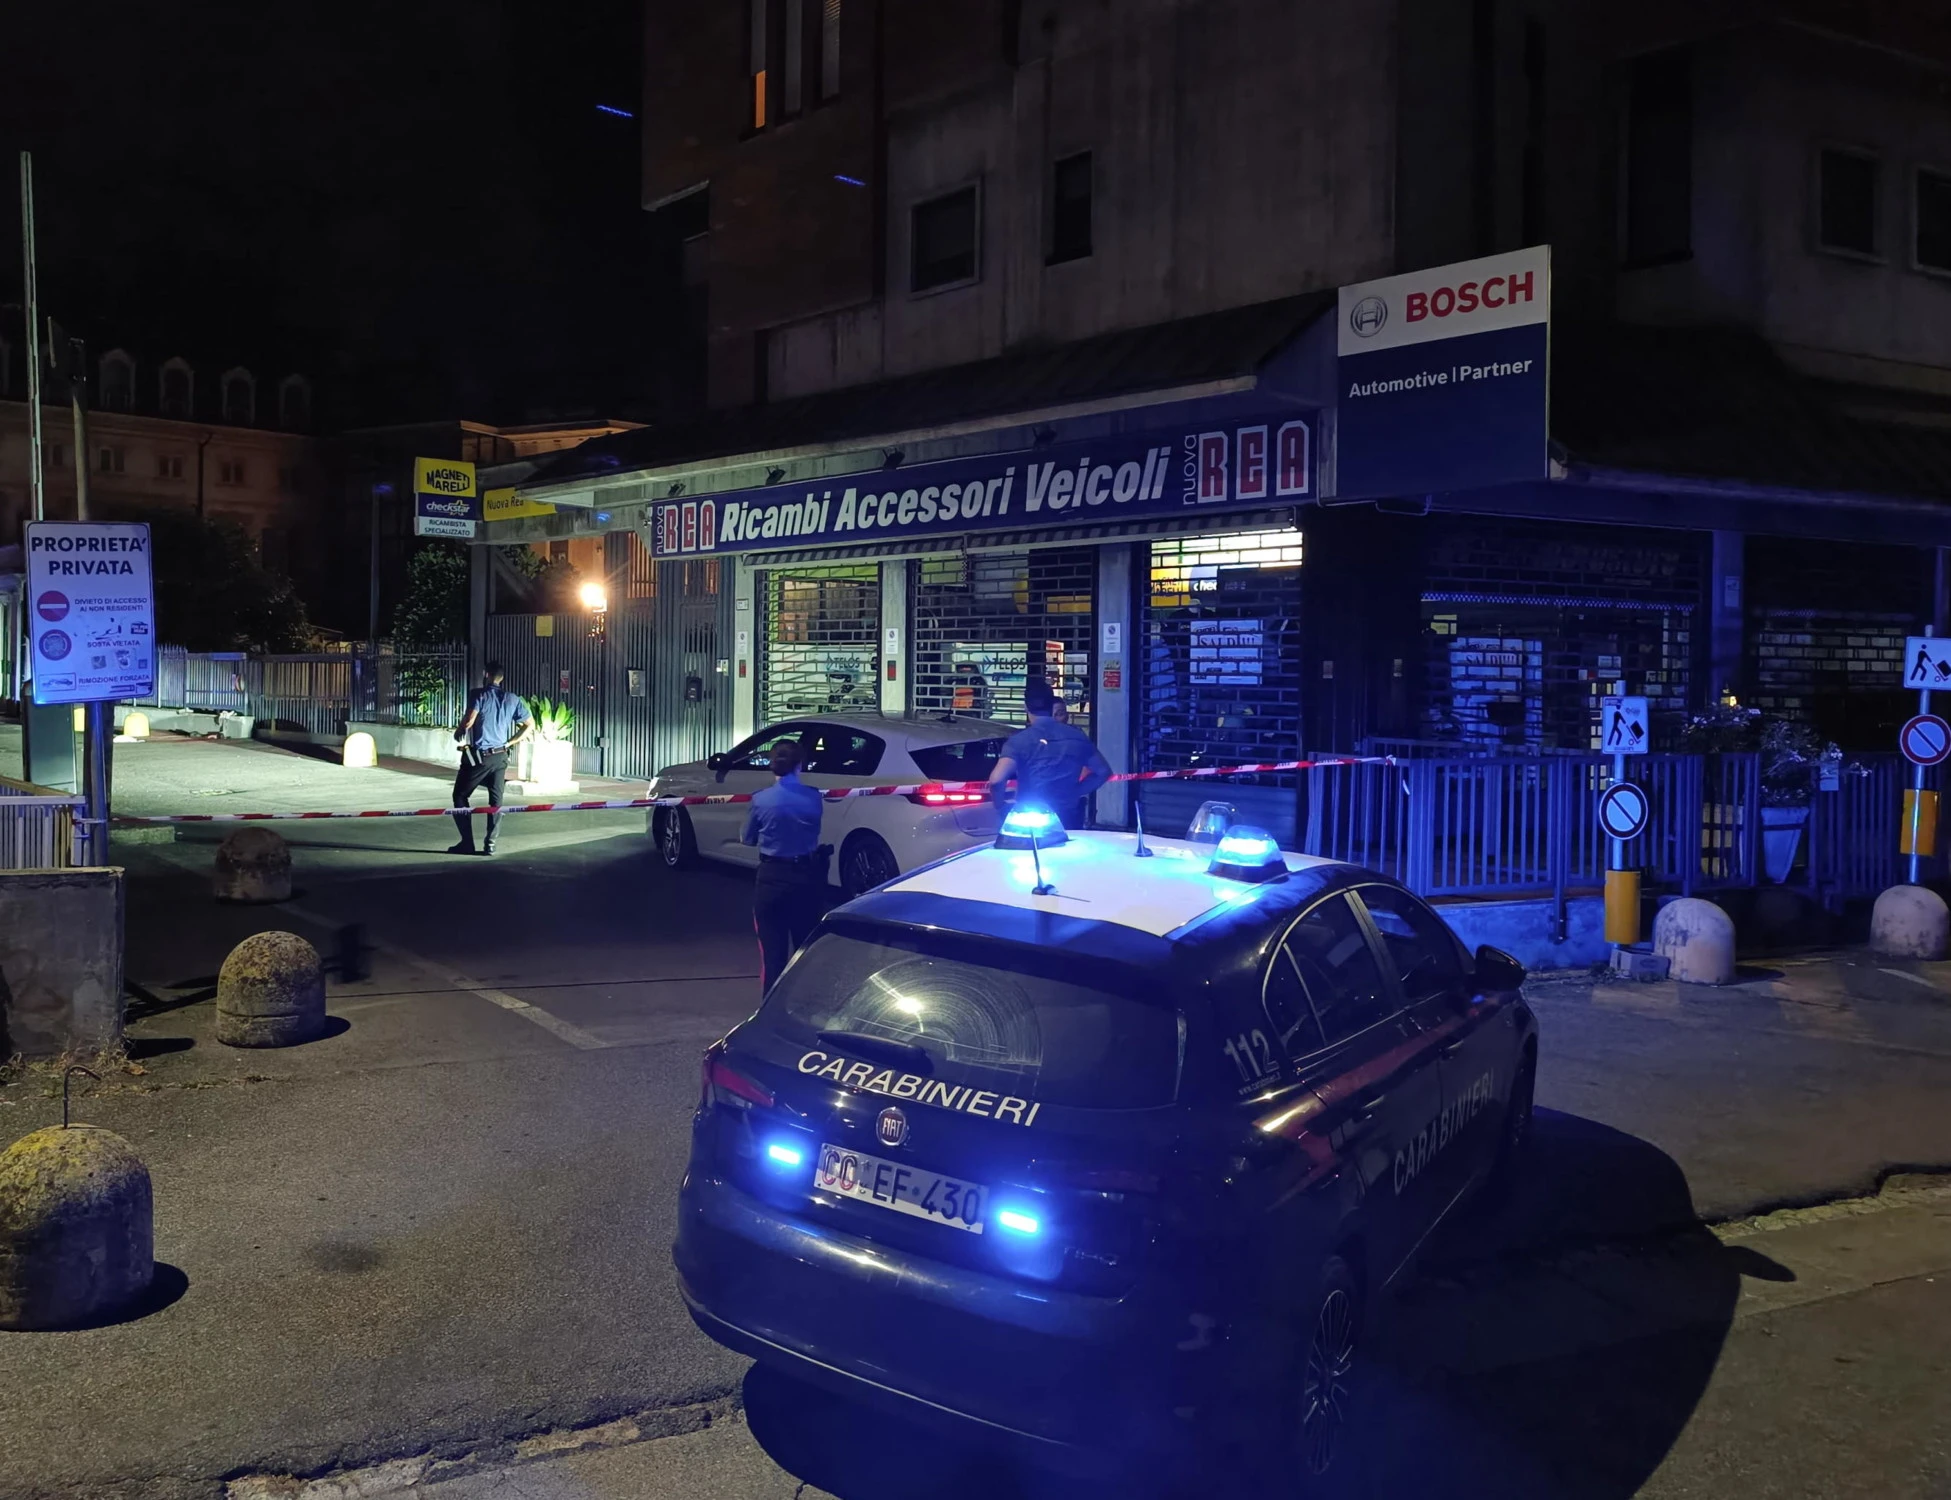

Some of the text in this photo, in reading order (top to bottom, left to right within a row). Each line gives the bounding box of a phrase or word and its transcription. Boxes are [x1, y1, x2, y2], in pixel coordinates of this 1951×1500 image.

[1406, 271, 1533, 323] BOSCH
[1349, 360, 1532, 398] Automotive Partner
[1183, 434, 1197, 505] nuova
[1197, 420, 1310, 503] REA
[426, 500, 470, 514] checkstar
[487, 499, 509, 511] Nuova
[720, 446, 1172, 542] Ricambi Accessori Veicoli
[424, 527, 470, 536] SPECIALIZZATO
[429, 519, 467, 528] RICAMBISTA
[656, 506, 664, 554] nuova
[663, 500, 716, 553] REA
[31, 537, 146, 552] PROPRIETA'
[48, 561, 133, 575] PRIVATA
[106, 604, 143, 612] RESIDENTI
[78, 674, 150, 684] RIMOZIONE FORZATA
[1223, 1028, 1280, 1082] 112
[797, 1051, 1041, 1127] CARABINIERI
[881, 1116, 903, 1138] FIAT
[1394, 1067, 1495, 1197] CARABINIERI
